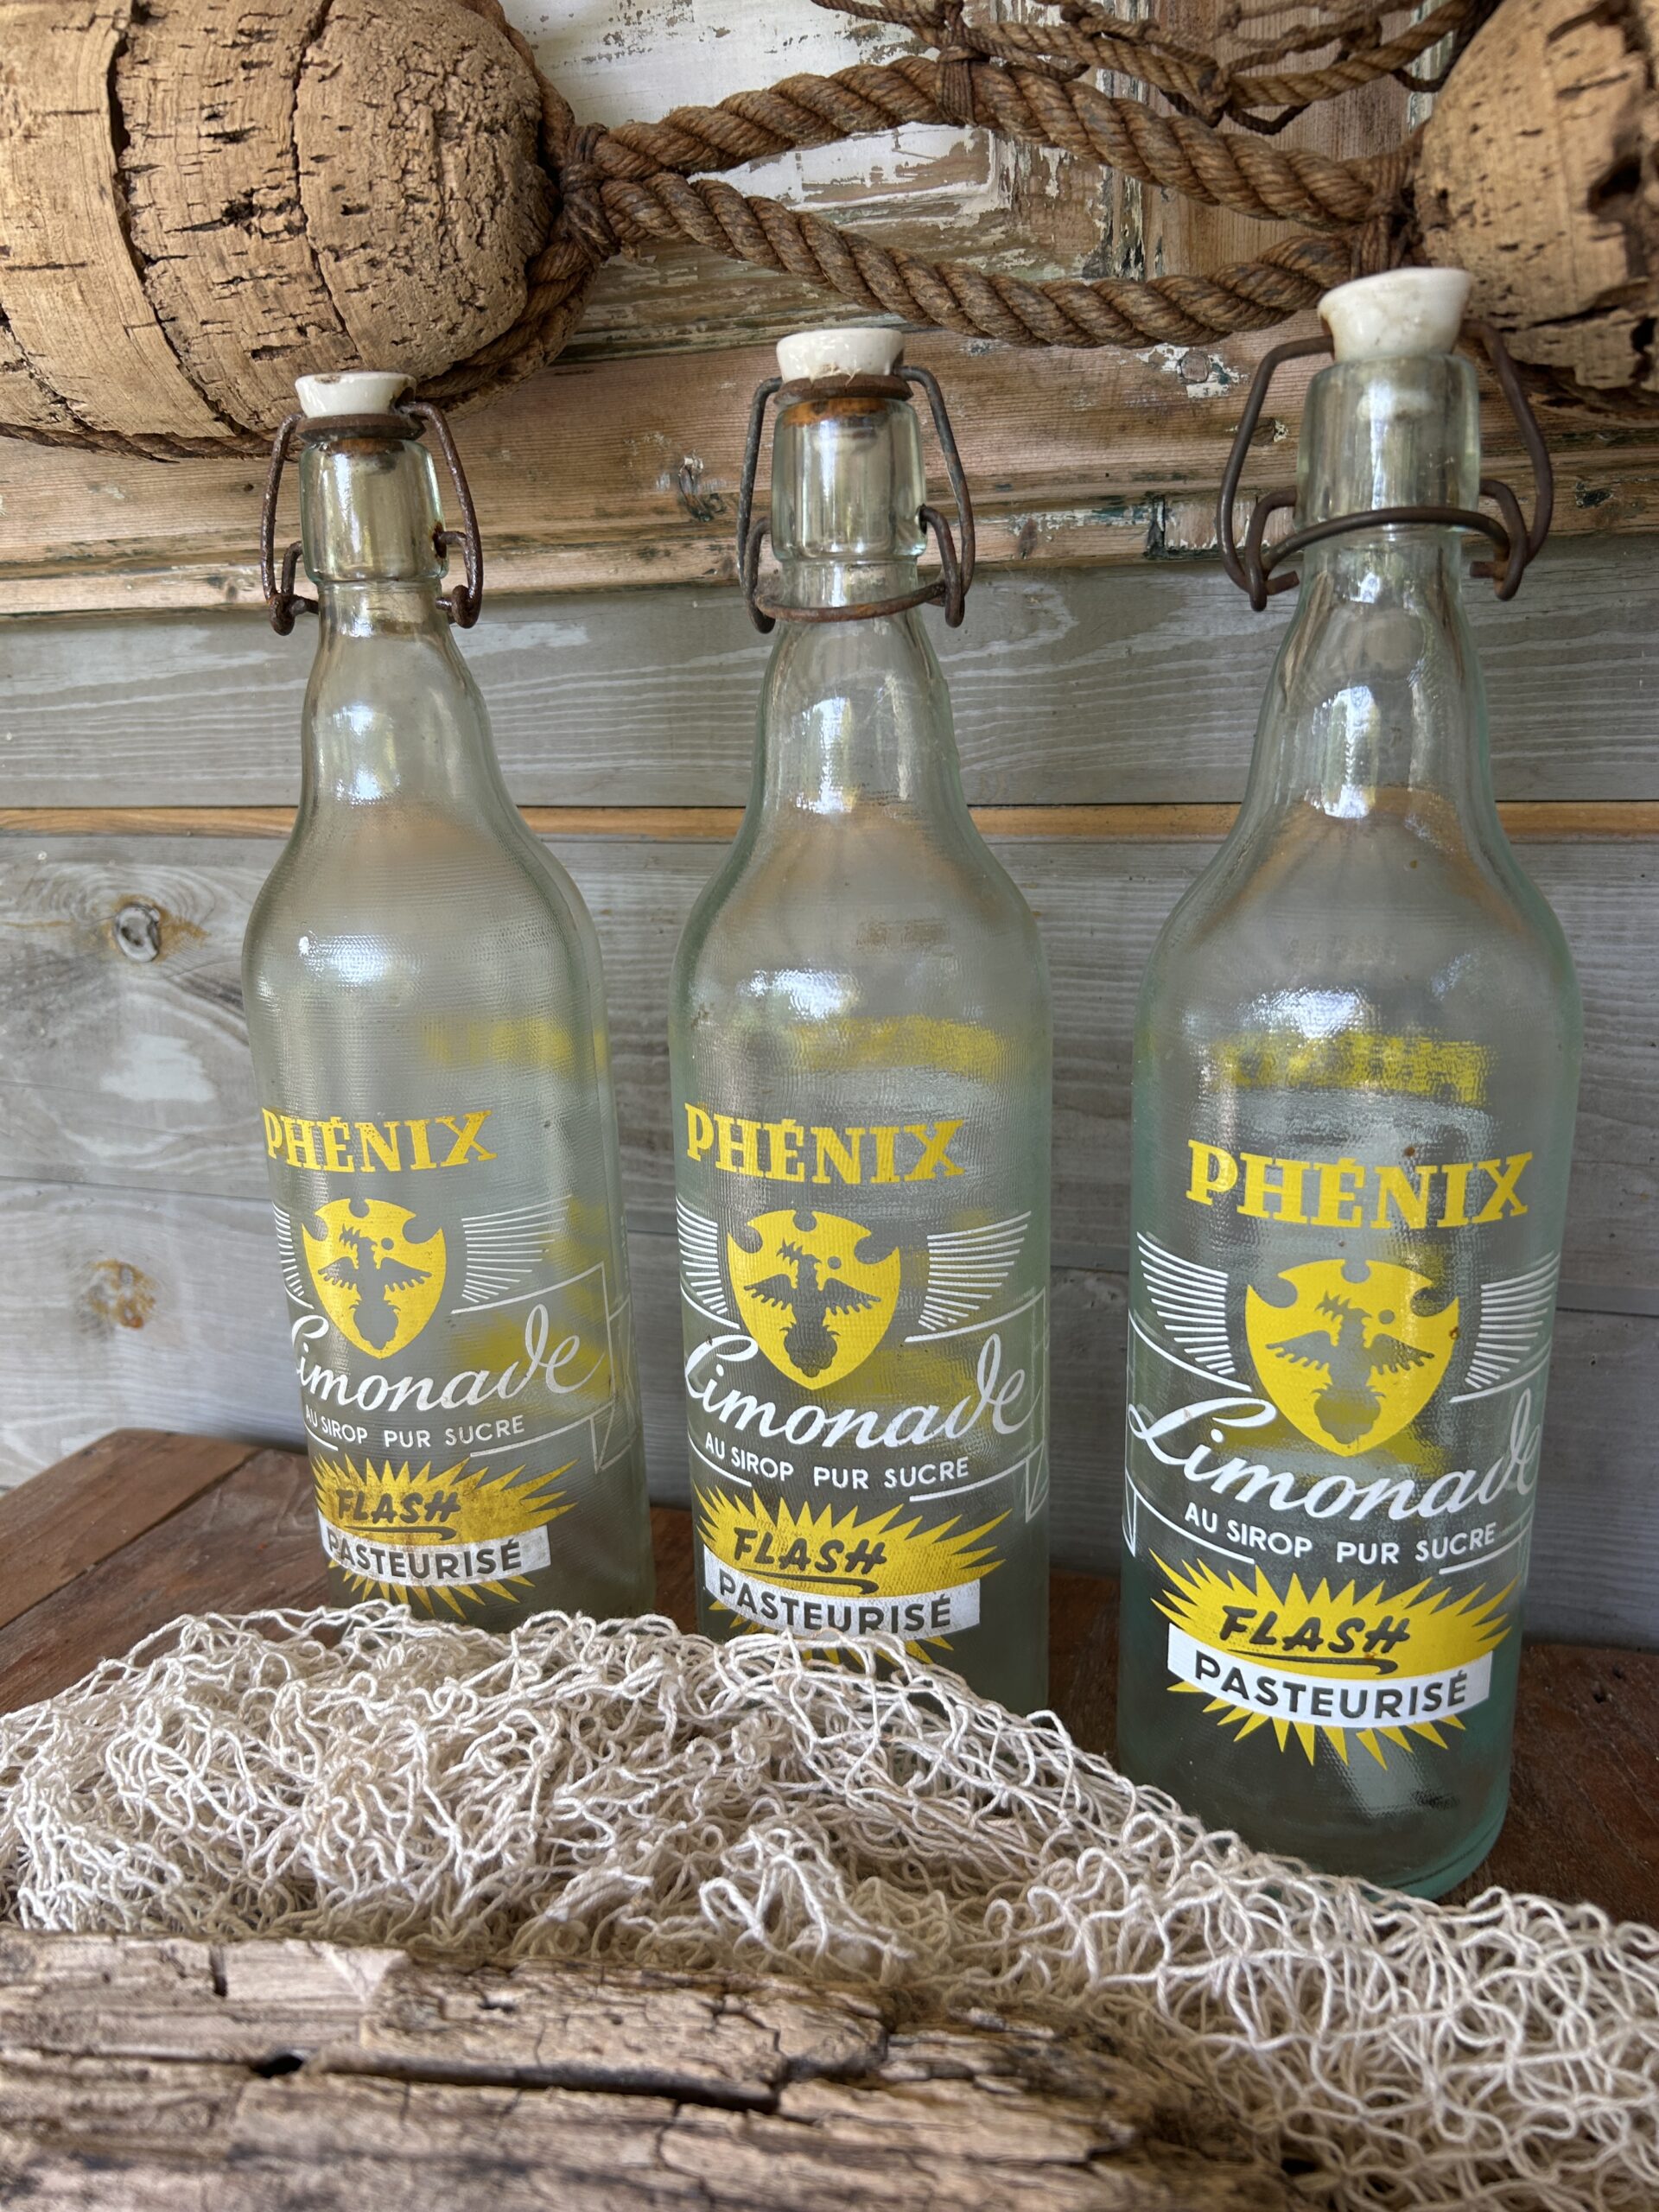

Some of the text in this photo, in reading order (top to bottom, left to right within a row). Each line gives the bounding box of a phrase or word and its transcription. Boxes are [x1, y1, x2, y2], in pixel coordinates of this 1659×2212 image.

[262, 1107, 499, 1173] PHÉNIX
[684, 1102, 965, 1184] PHÉNIX
[1185, 1139, 1535, 1230] PHÉNIX
[683, 1332, 1042, 1452] Limonade
[305, 1403, 525, 1449] AU SIROP PUR SUCRE
[1127, 1387, 1542, 1522] Limonade
[704, 1431, 969, 1490] AU SIROP PUR SUCRE
[335, 1486, 461, 1523] FLASH
[1184, 1502, 1497, 1567] AU SIROP PUR SUCRE
[327, 1527, 521, 1580] PASTEURISÉ
[733, 1527, 887, 1574] FLASH
[719, 1568, 951, 1634] PASTEURISÉ
[1218, 1605, 1413, 1654] FLASH
[1194, 1649, 1468, 1719] PASTEURISÉ
